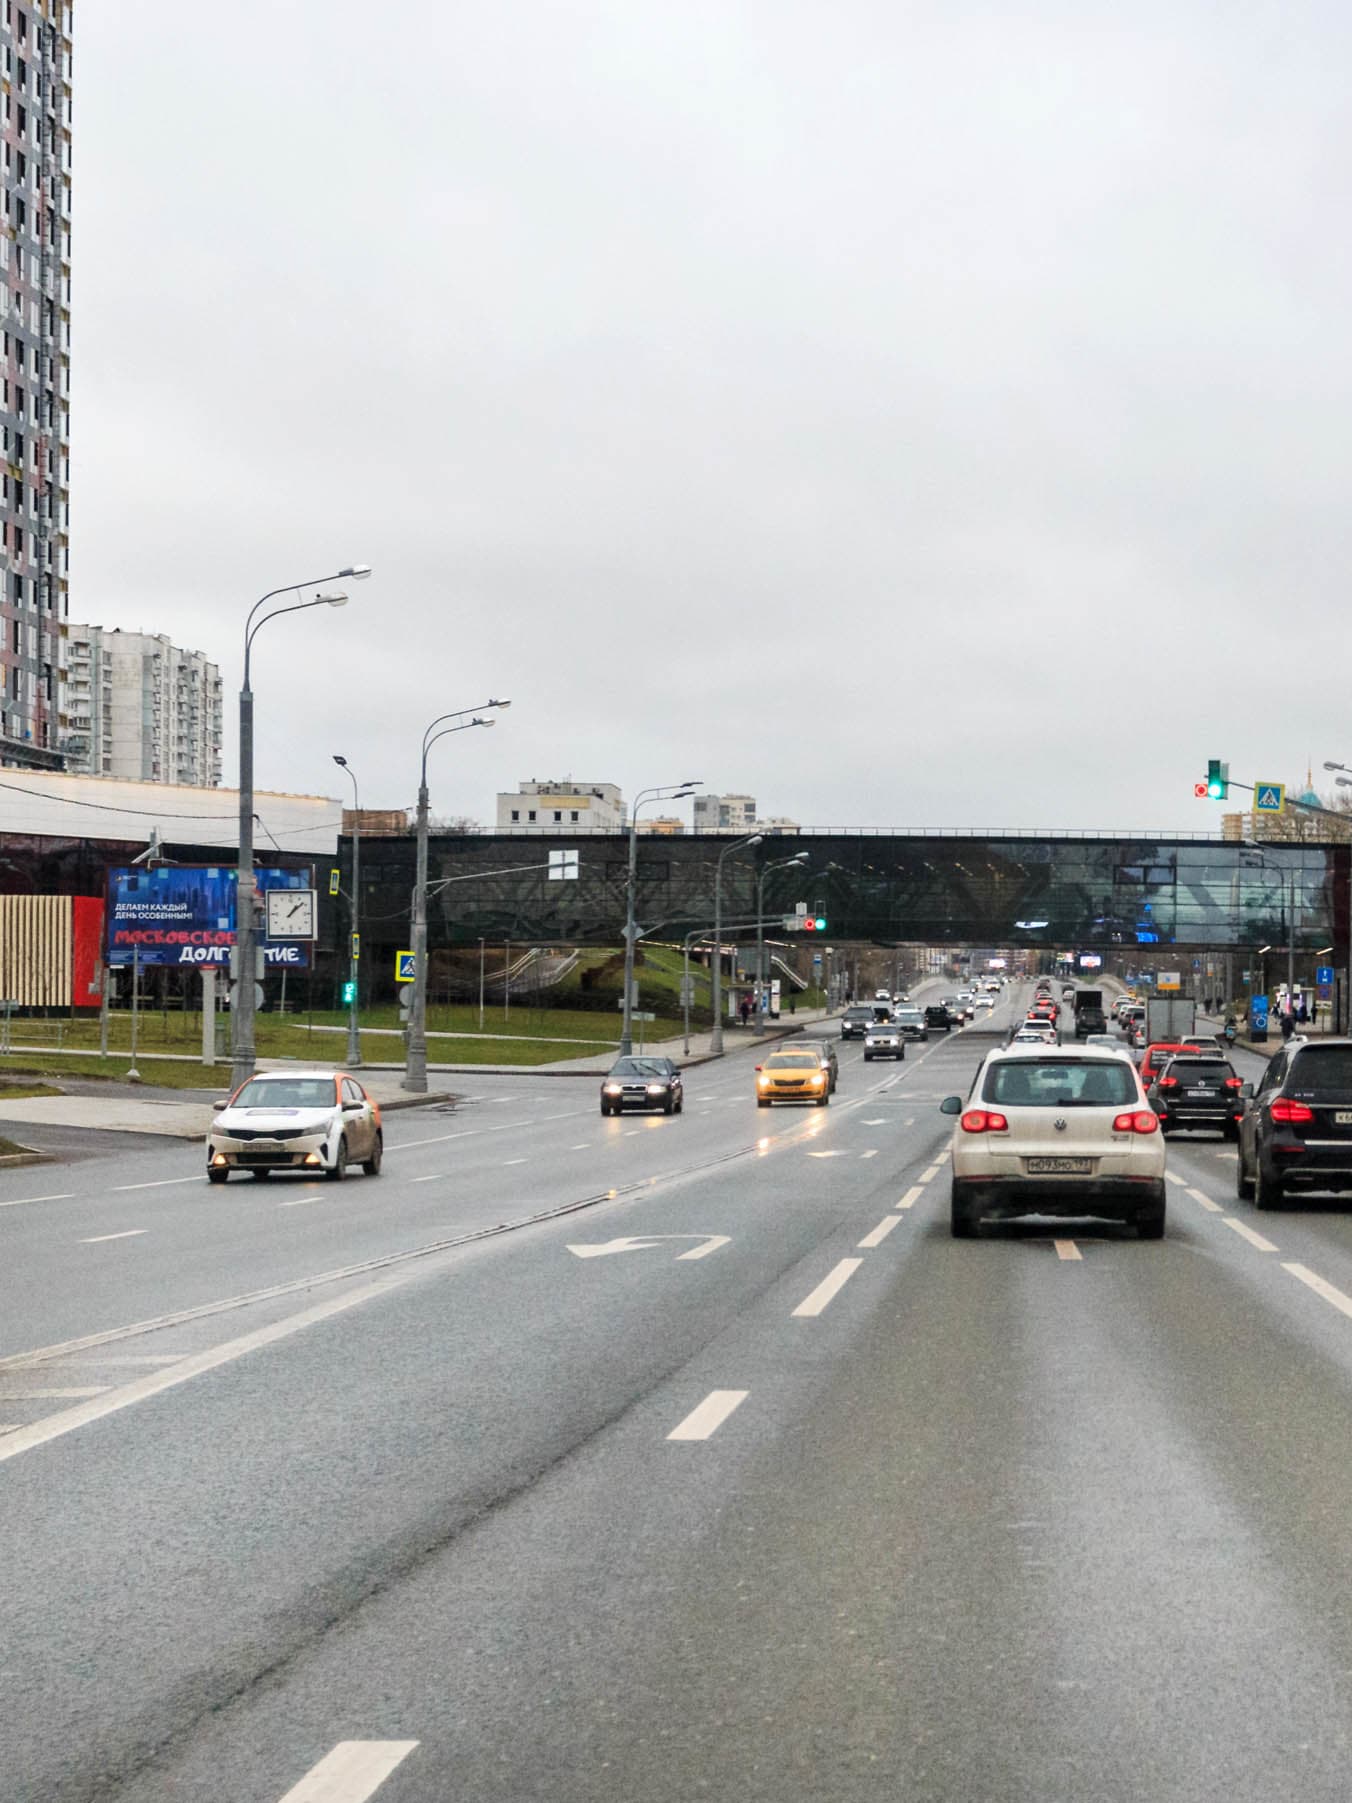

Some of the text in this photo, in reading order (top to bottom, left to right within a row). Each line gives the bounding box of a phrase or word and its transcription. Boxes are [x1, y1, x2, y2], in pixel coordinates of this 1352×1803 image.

[115, 902, 188, 911] ДЕЛАЕМ КАЖДЫЙ
[114, 930, 239, 945] МОСКОВСКОЕ
[179, 946, 299, 963] ДОЛГТИЕ
